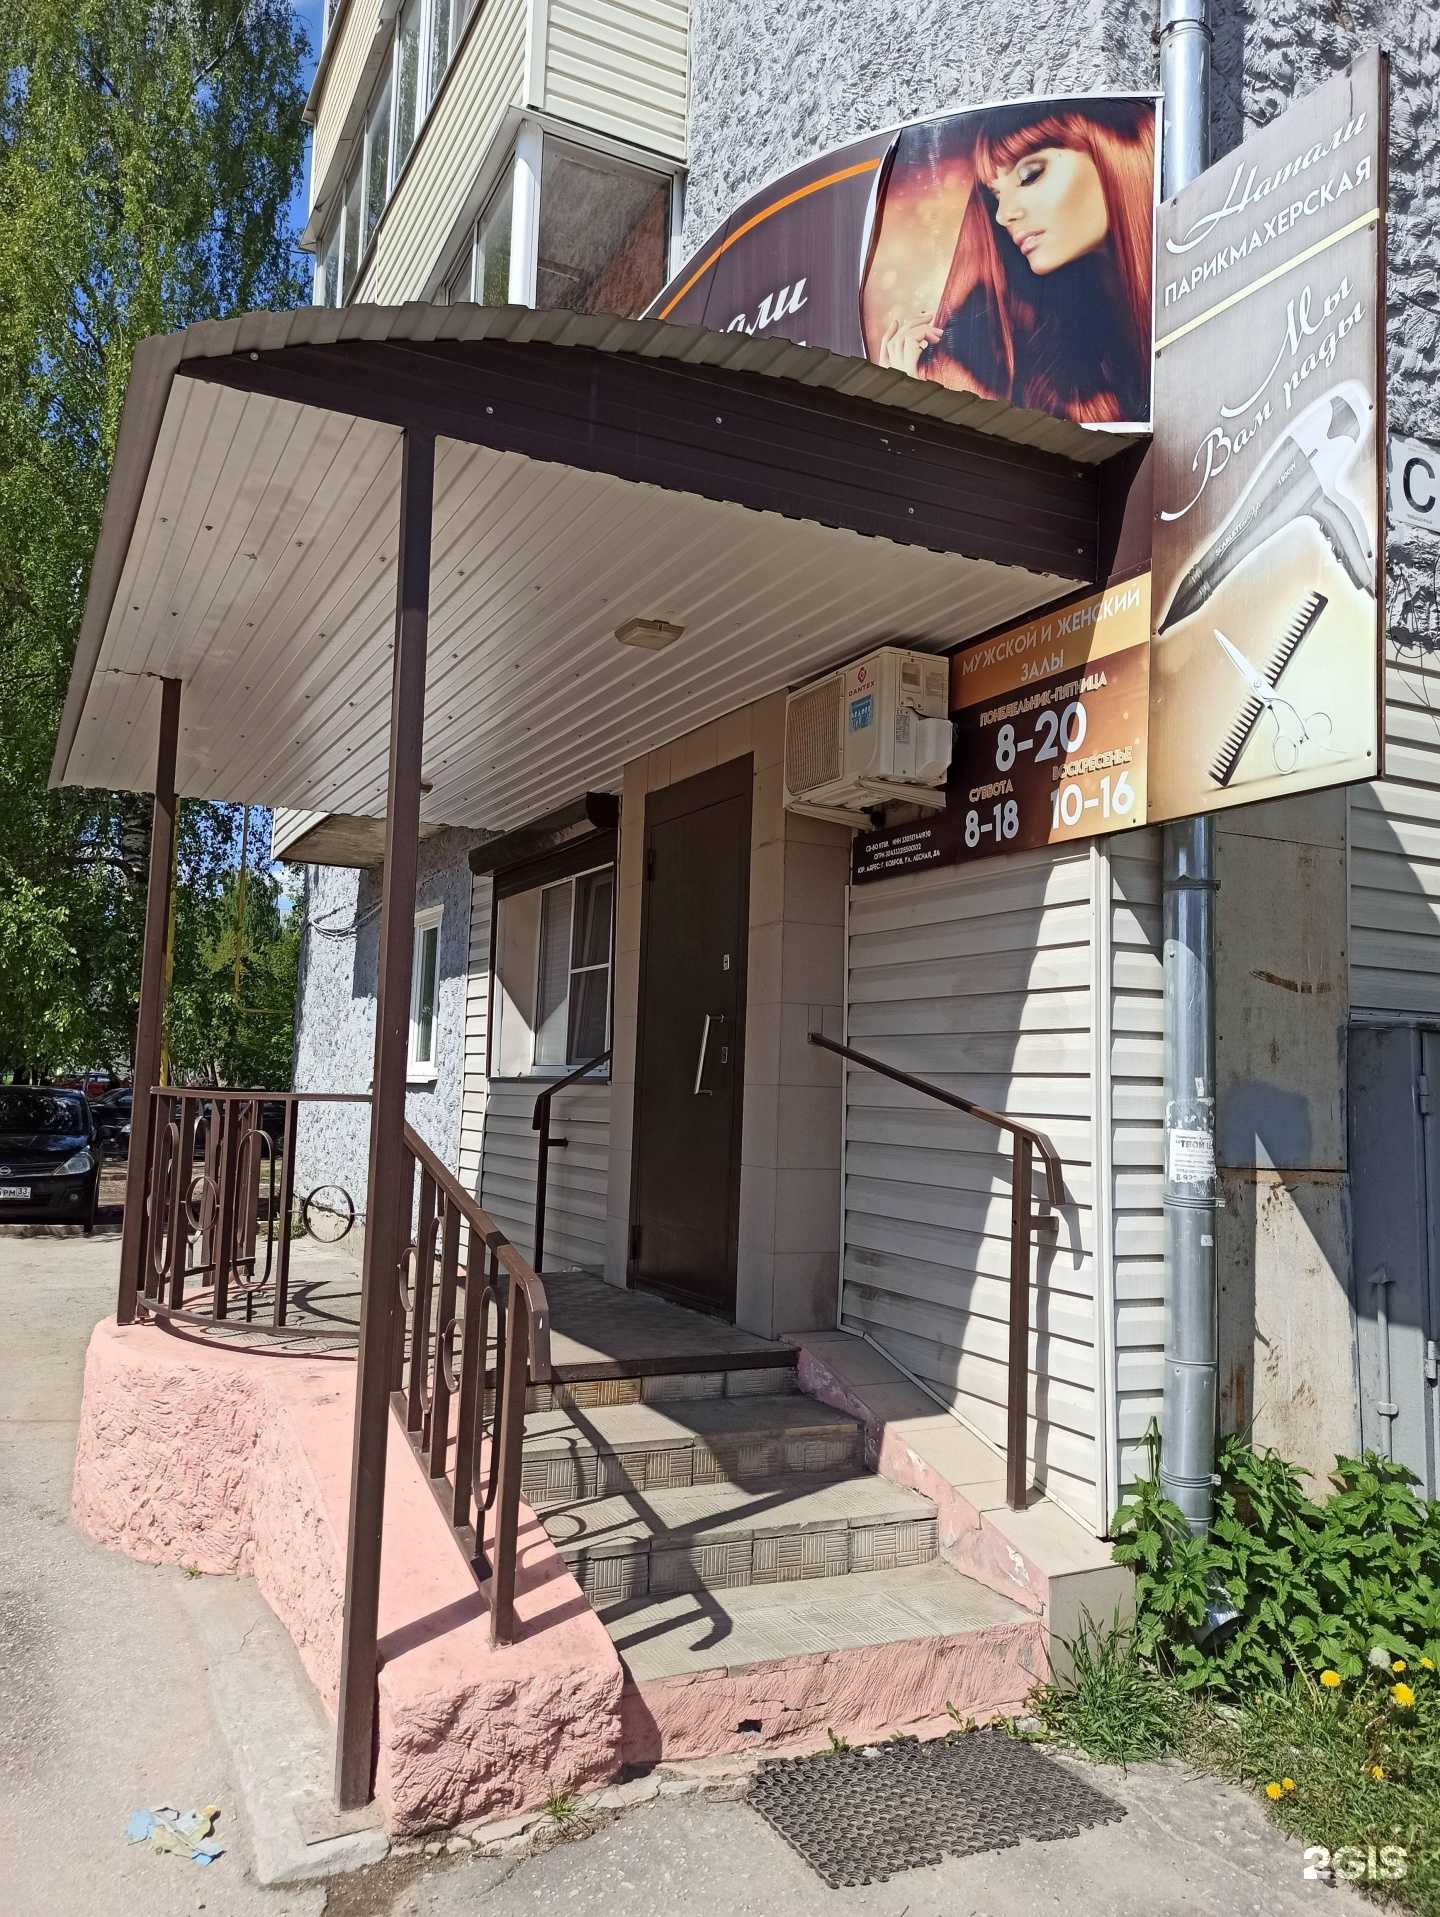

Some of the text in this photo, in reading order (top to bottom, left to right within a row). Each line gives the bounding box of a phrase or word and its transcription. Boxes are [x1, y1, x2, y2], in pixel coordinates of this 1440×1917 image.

[1166, 112, 1368, 254] Натали
[1163, 155, 1373, 308] ПАРИКМАХЕРСКАЯ
[1220, 276, 1354, 418] Мы
[1160, 301, 1367, 521] Вам рады
[961, 583, 1141, 676] МУЖСКОЙ И ЖЕНСКИЙ
[848, 681, 875, 697] DANTEX
[1020, 649, 1064, 682] ЗАЛЫ
[995, 701, 1087, 772] 8-20
[1052, 746, 1133, 782] ВОСКРЕСЕНЬЕ
[968, 778, 1014, 803] СУББОТА
[1050, 770, 1136, 830] 10-16
[964, 799, 1020, 848] 8-18
